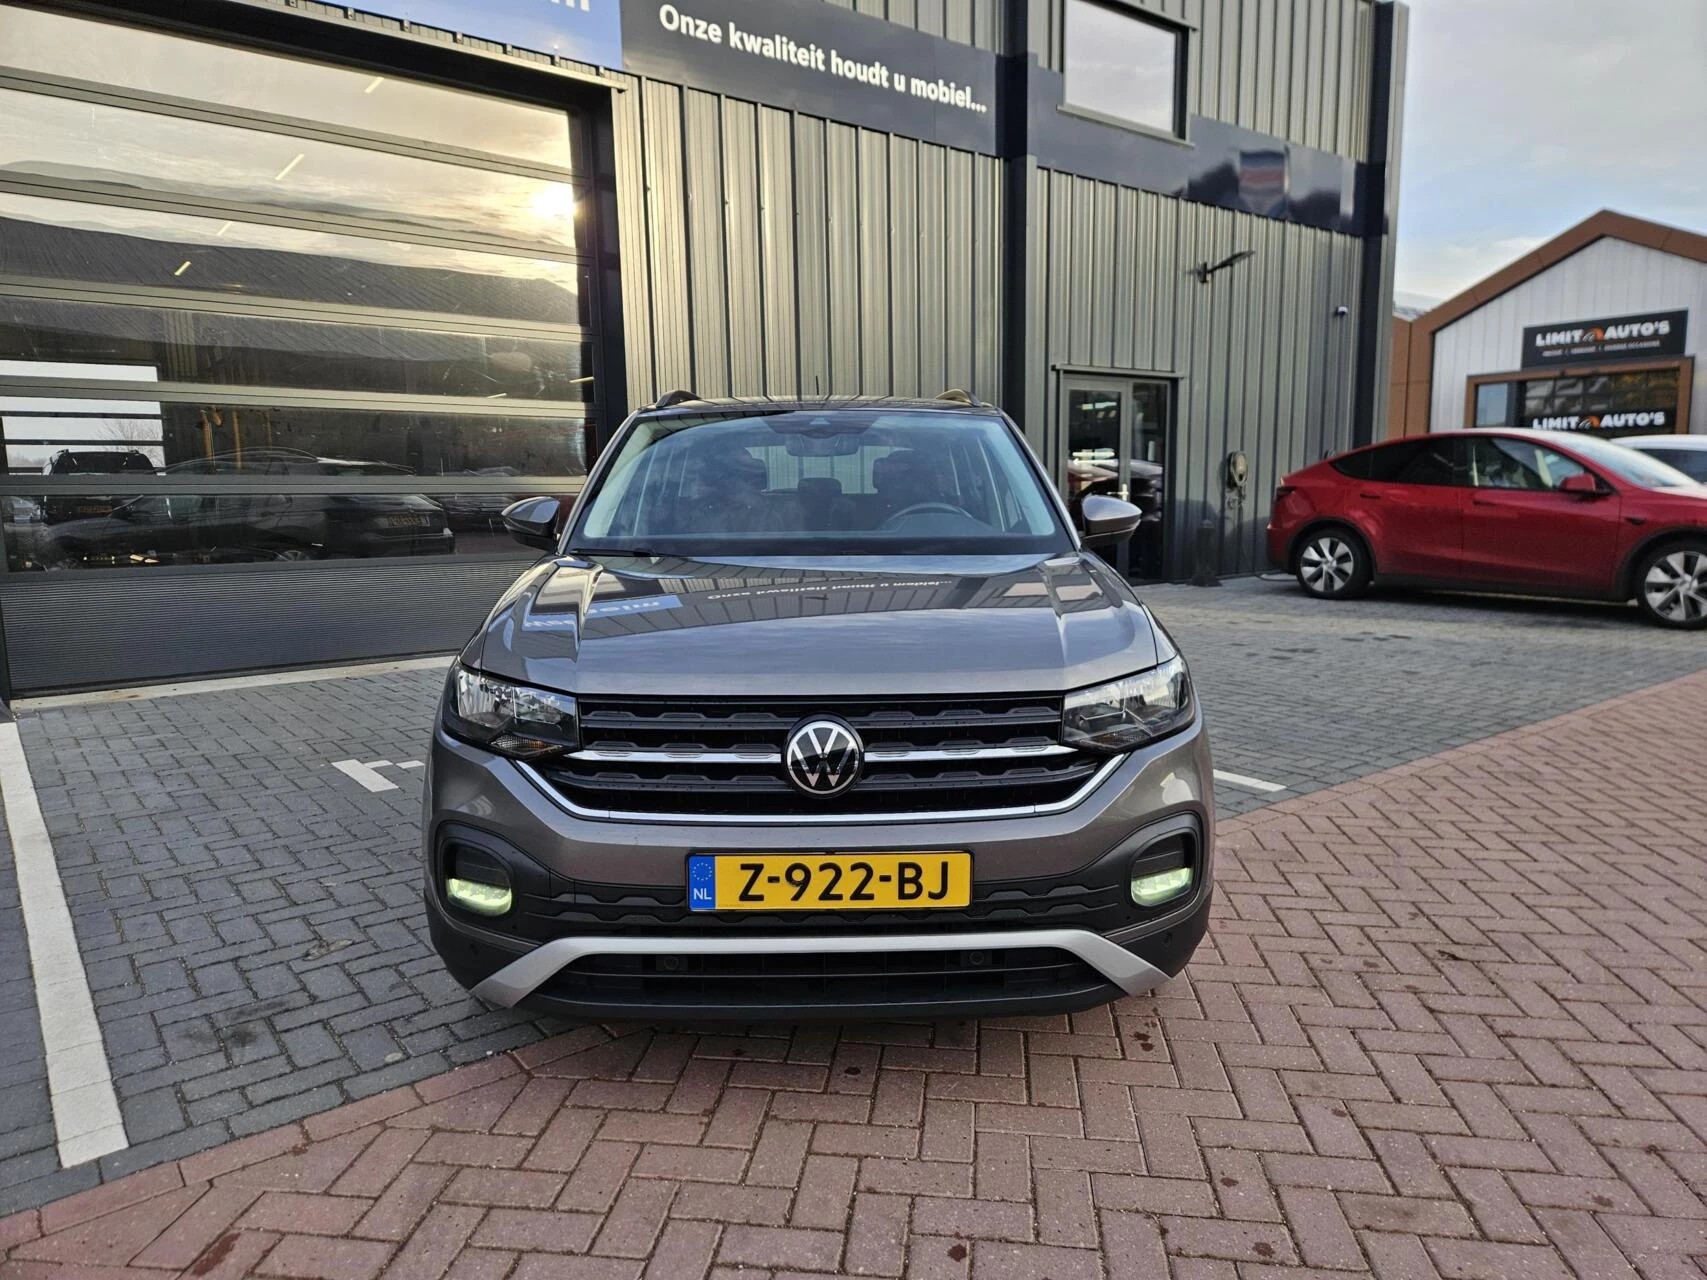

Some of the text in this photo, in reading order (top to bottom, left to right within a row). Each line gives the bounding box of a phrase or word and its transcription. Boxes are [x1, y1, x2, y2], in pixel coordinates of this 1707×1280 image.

[659, 4, 987, 113] Onze kwaliteit houdt u mobiel...
[1535, 320, 1670, 347] LIMIT AUTO'S
[1532, 411, 1665, 430] LIMIT AUTO'S
[693, 861, 949, 902] NL Z-922-BJ
